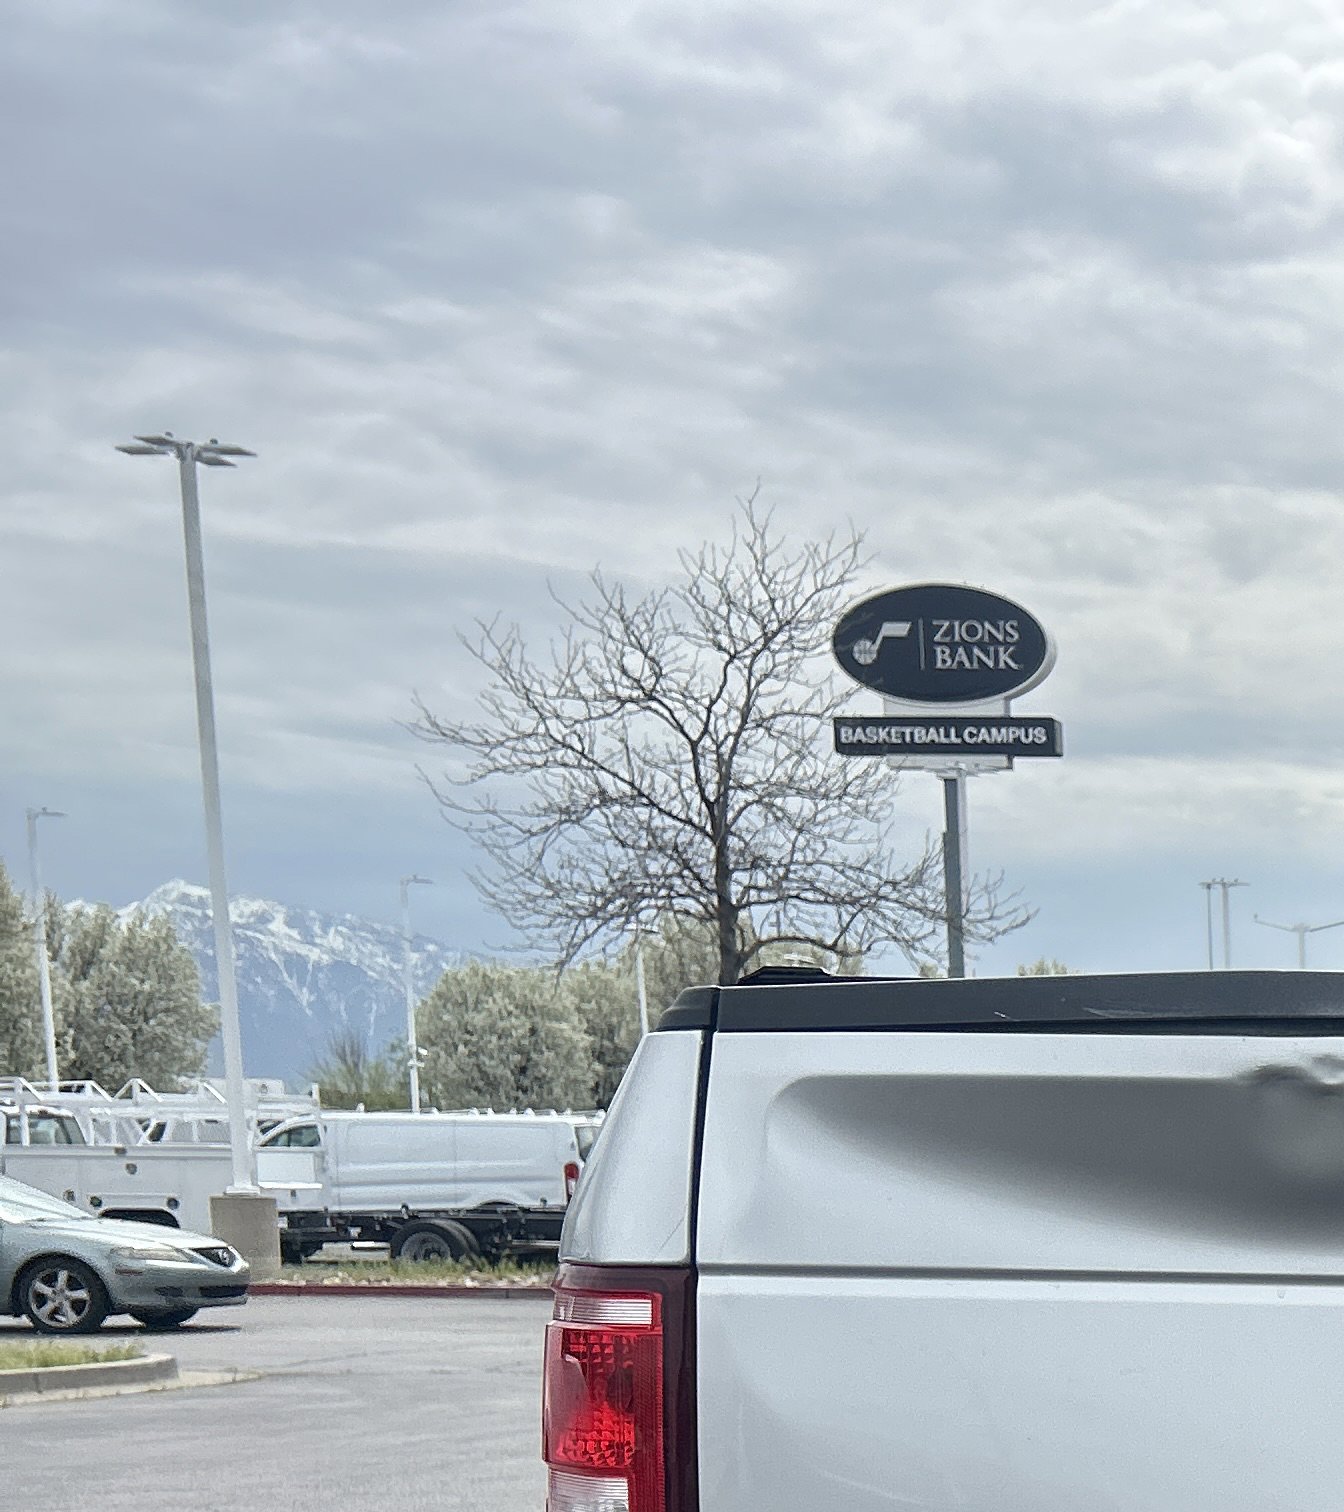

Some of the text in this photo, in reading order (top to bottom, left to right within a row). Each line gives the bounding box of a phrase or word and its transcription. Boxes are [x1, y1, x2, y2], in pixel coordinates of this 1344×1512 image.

[931, 618, 1021, 644] ZIONS
[934, 644, 1021, 671] BANK
[839, 725, 1048, 745] BASKETBALL CAMPUS
